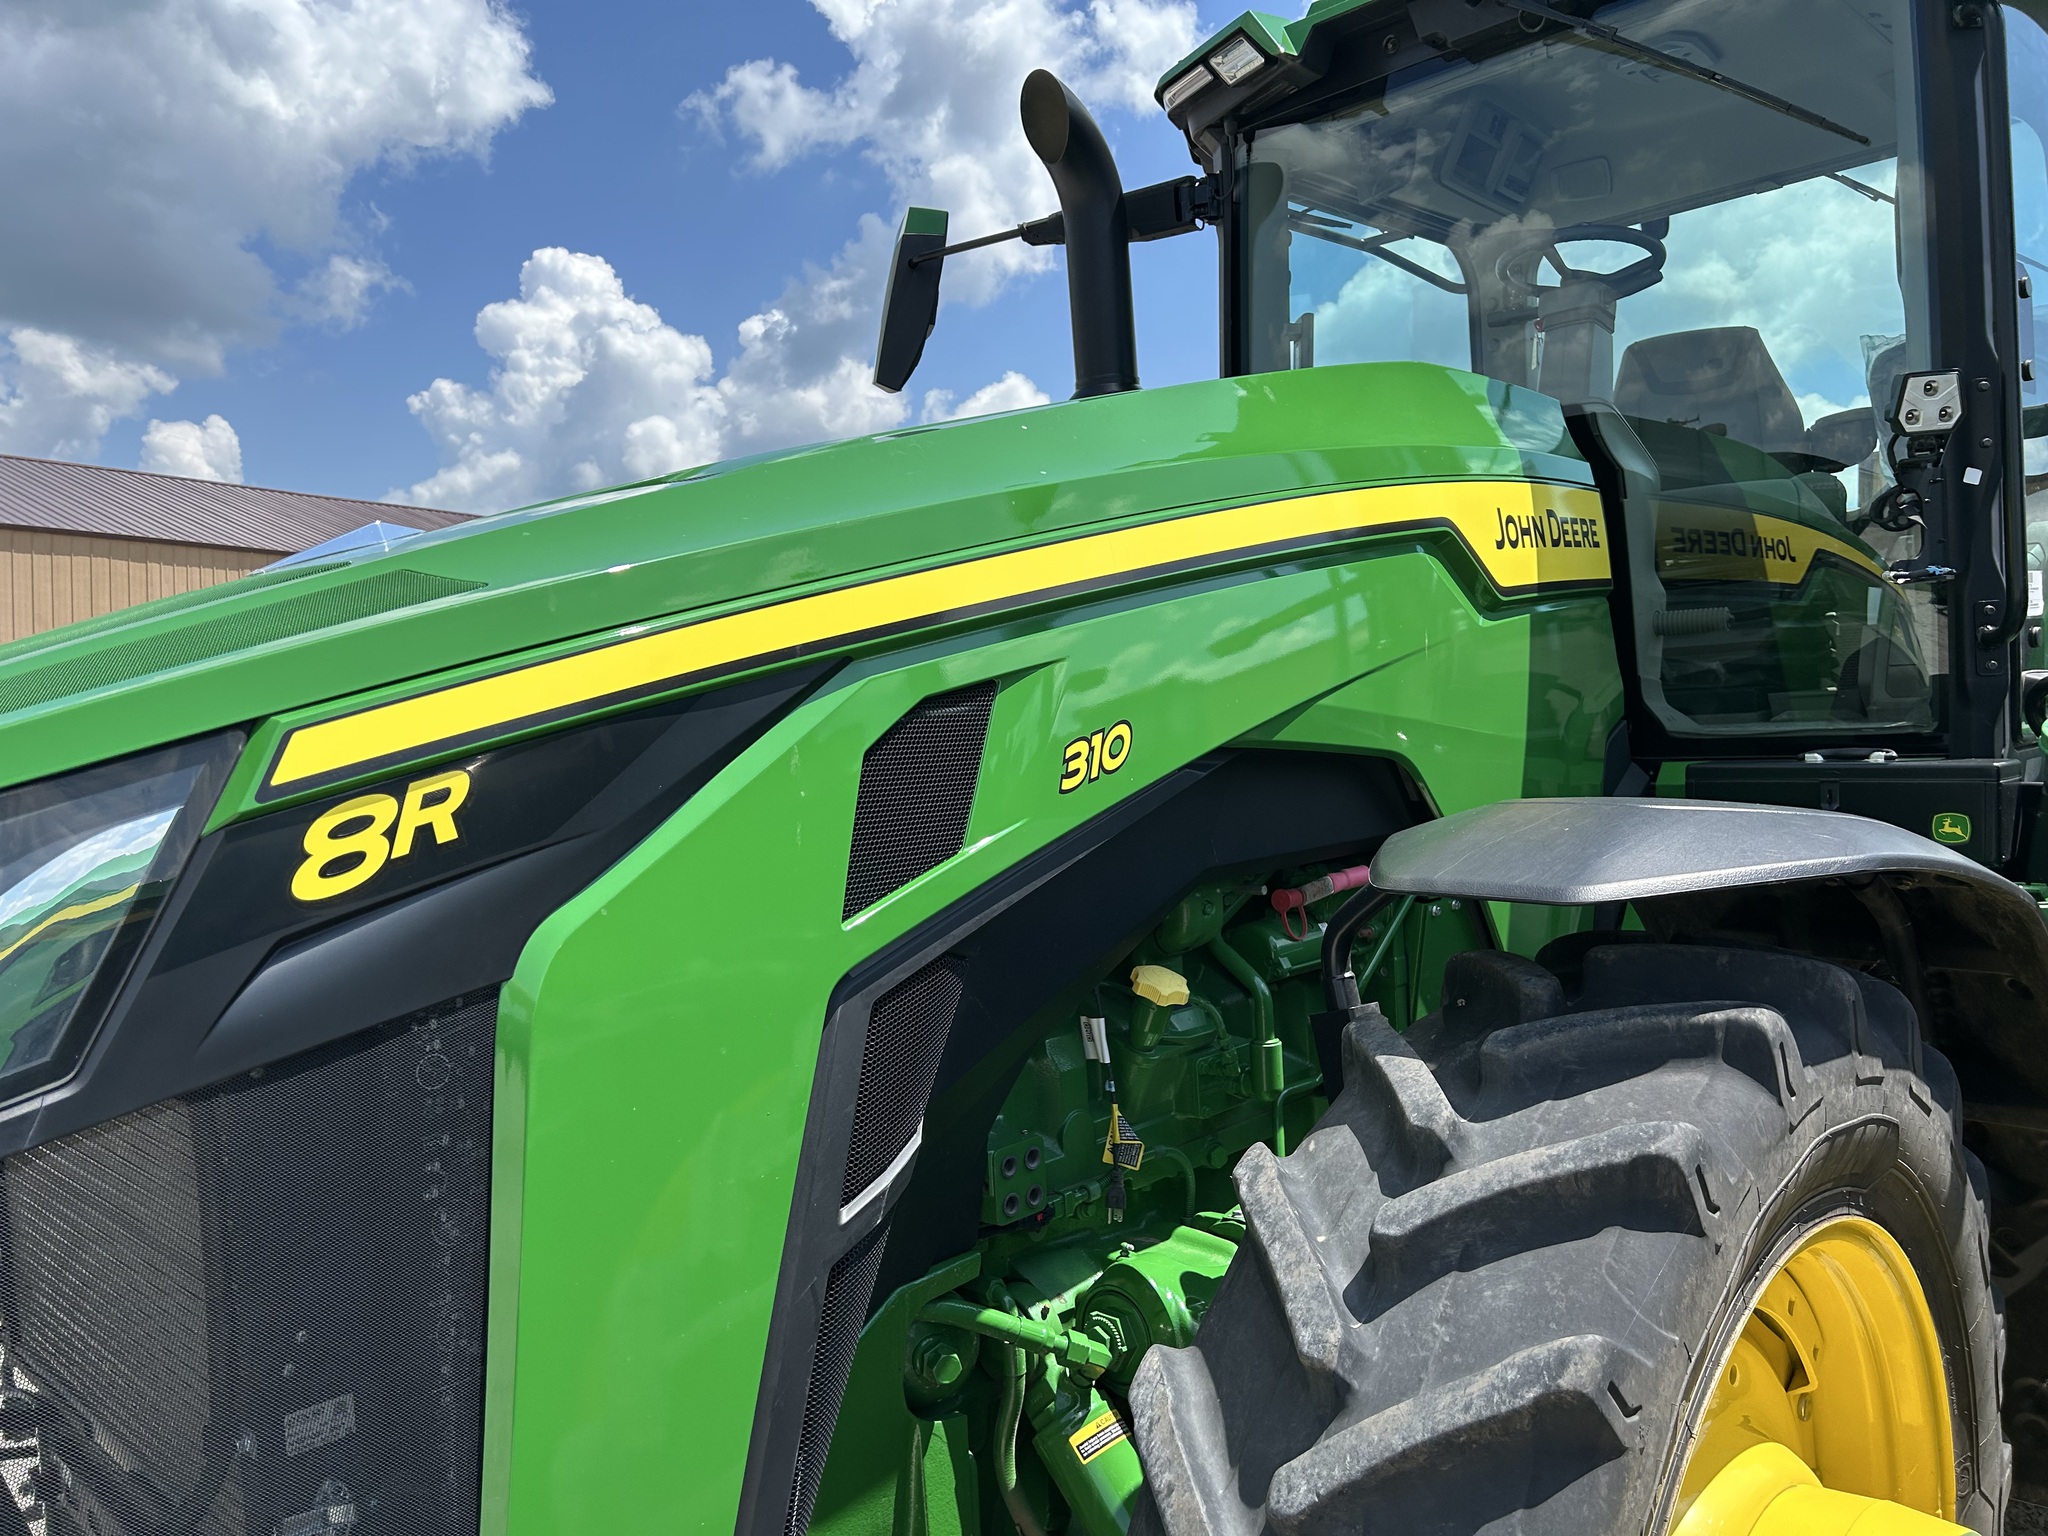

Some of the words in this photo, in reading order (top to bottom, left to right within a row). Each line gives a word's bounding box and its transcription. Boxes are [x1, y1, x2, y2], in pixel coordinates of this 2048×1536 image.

[1495, 507, 1547, 550] JOHN
[1546, 508, 1600, 549] DEERE
[1059, 719, 1133, 794] 310
[290, 769, 471, 901] 8R
